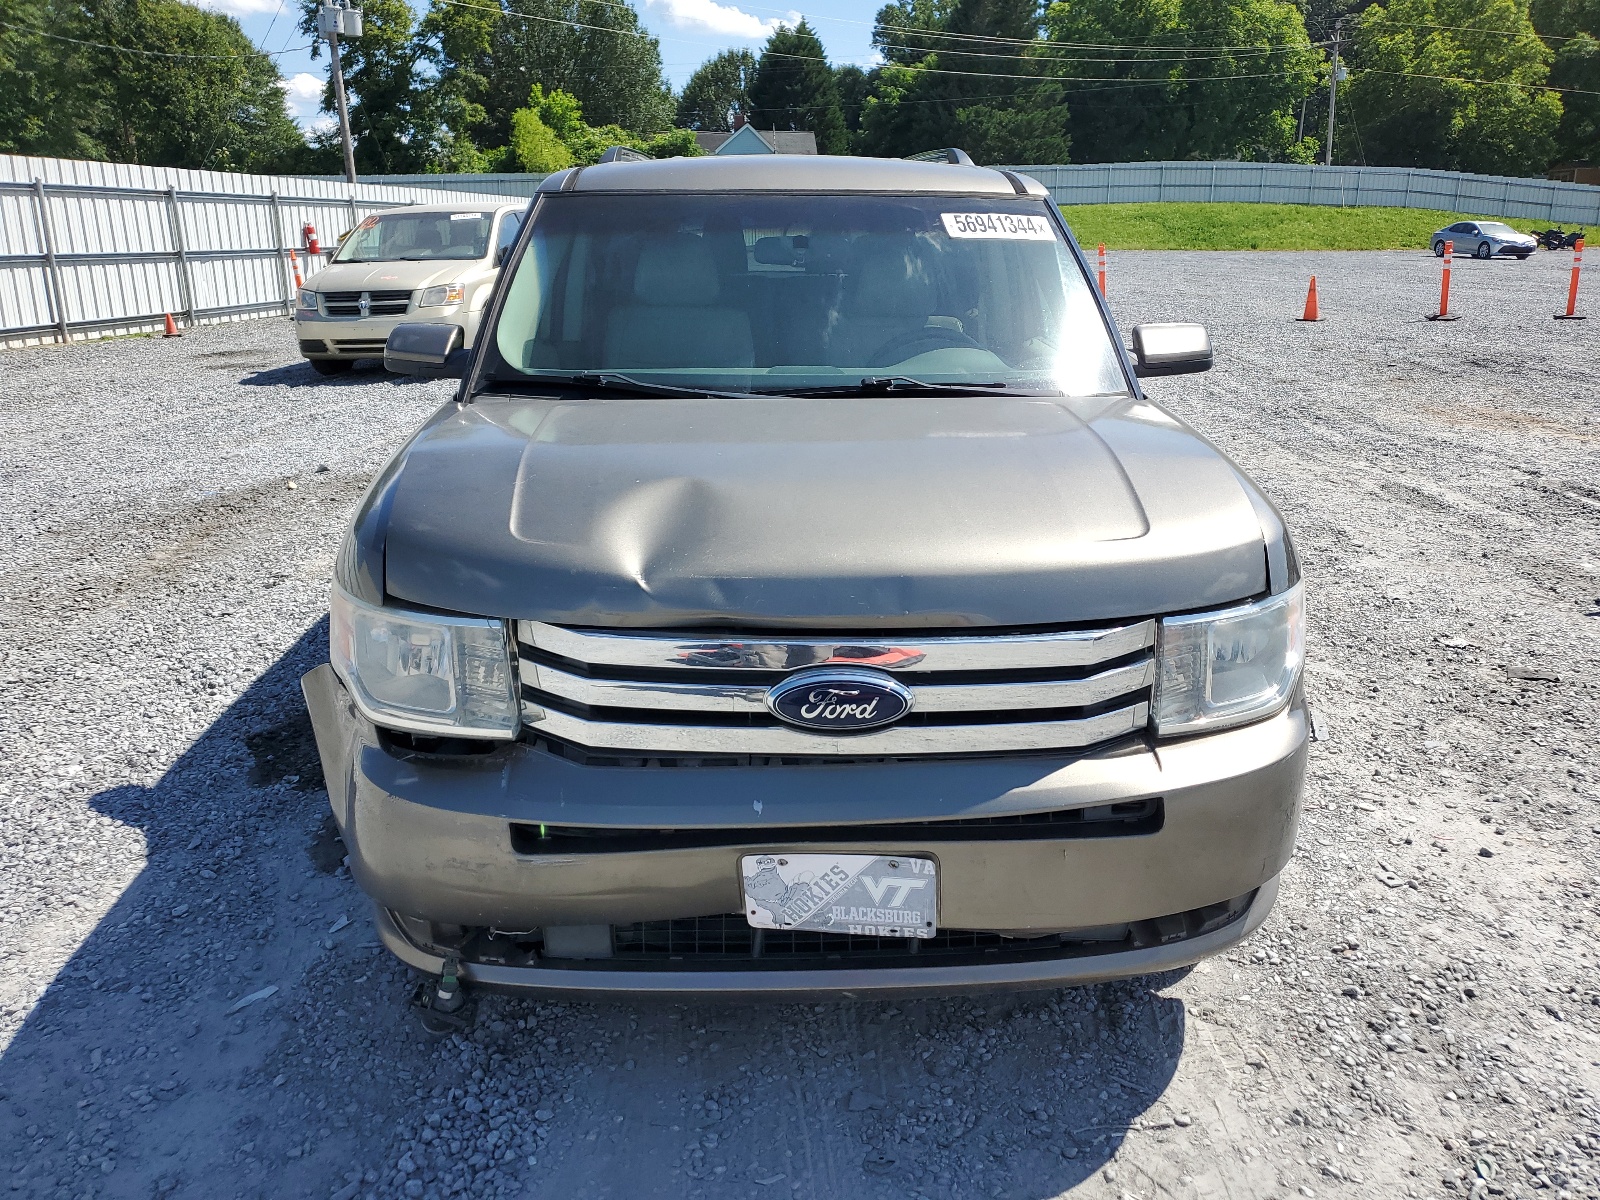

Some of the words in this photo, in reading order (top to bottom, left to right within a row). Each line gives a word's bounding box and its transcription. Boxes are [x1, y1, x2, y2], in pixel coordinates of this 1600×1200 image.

[801, 689, 879, 719] Ford
[781, 865, 850, 923] HOKIES
[859, 875, 929, 908] VT
[832, 905, 921, 924] BLACKSBURG
[848, 924, 929, 938] HOKIES
